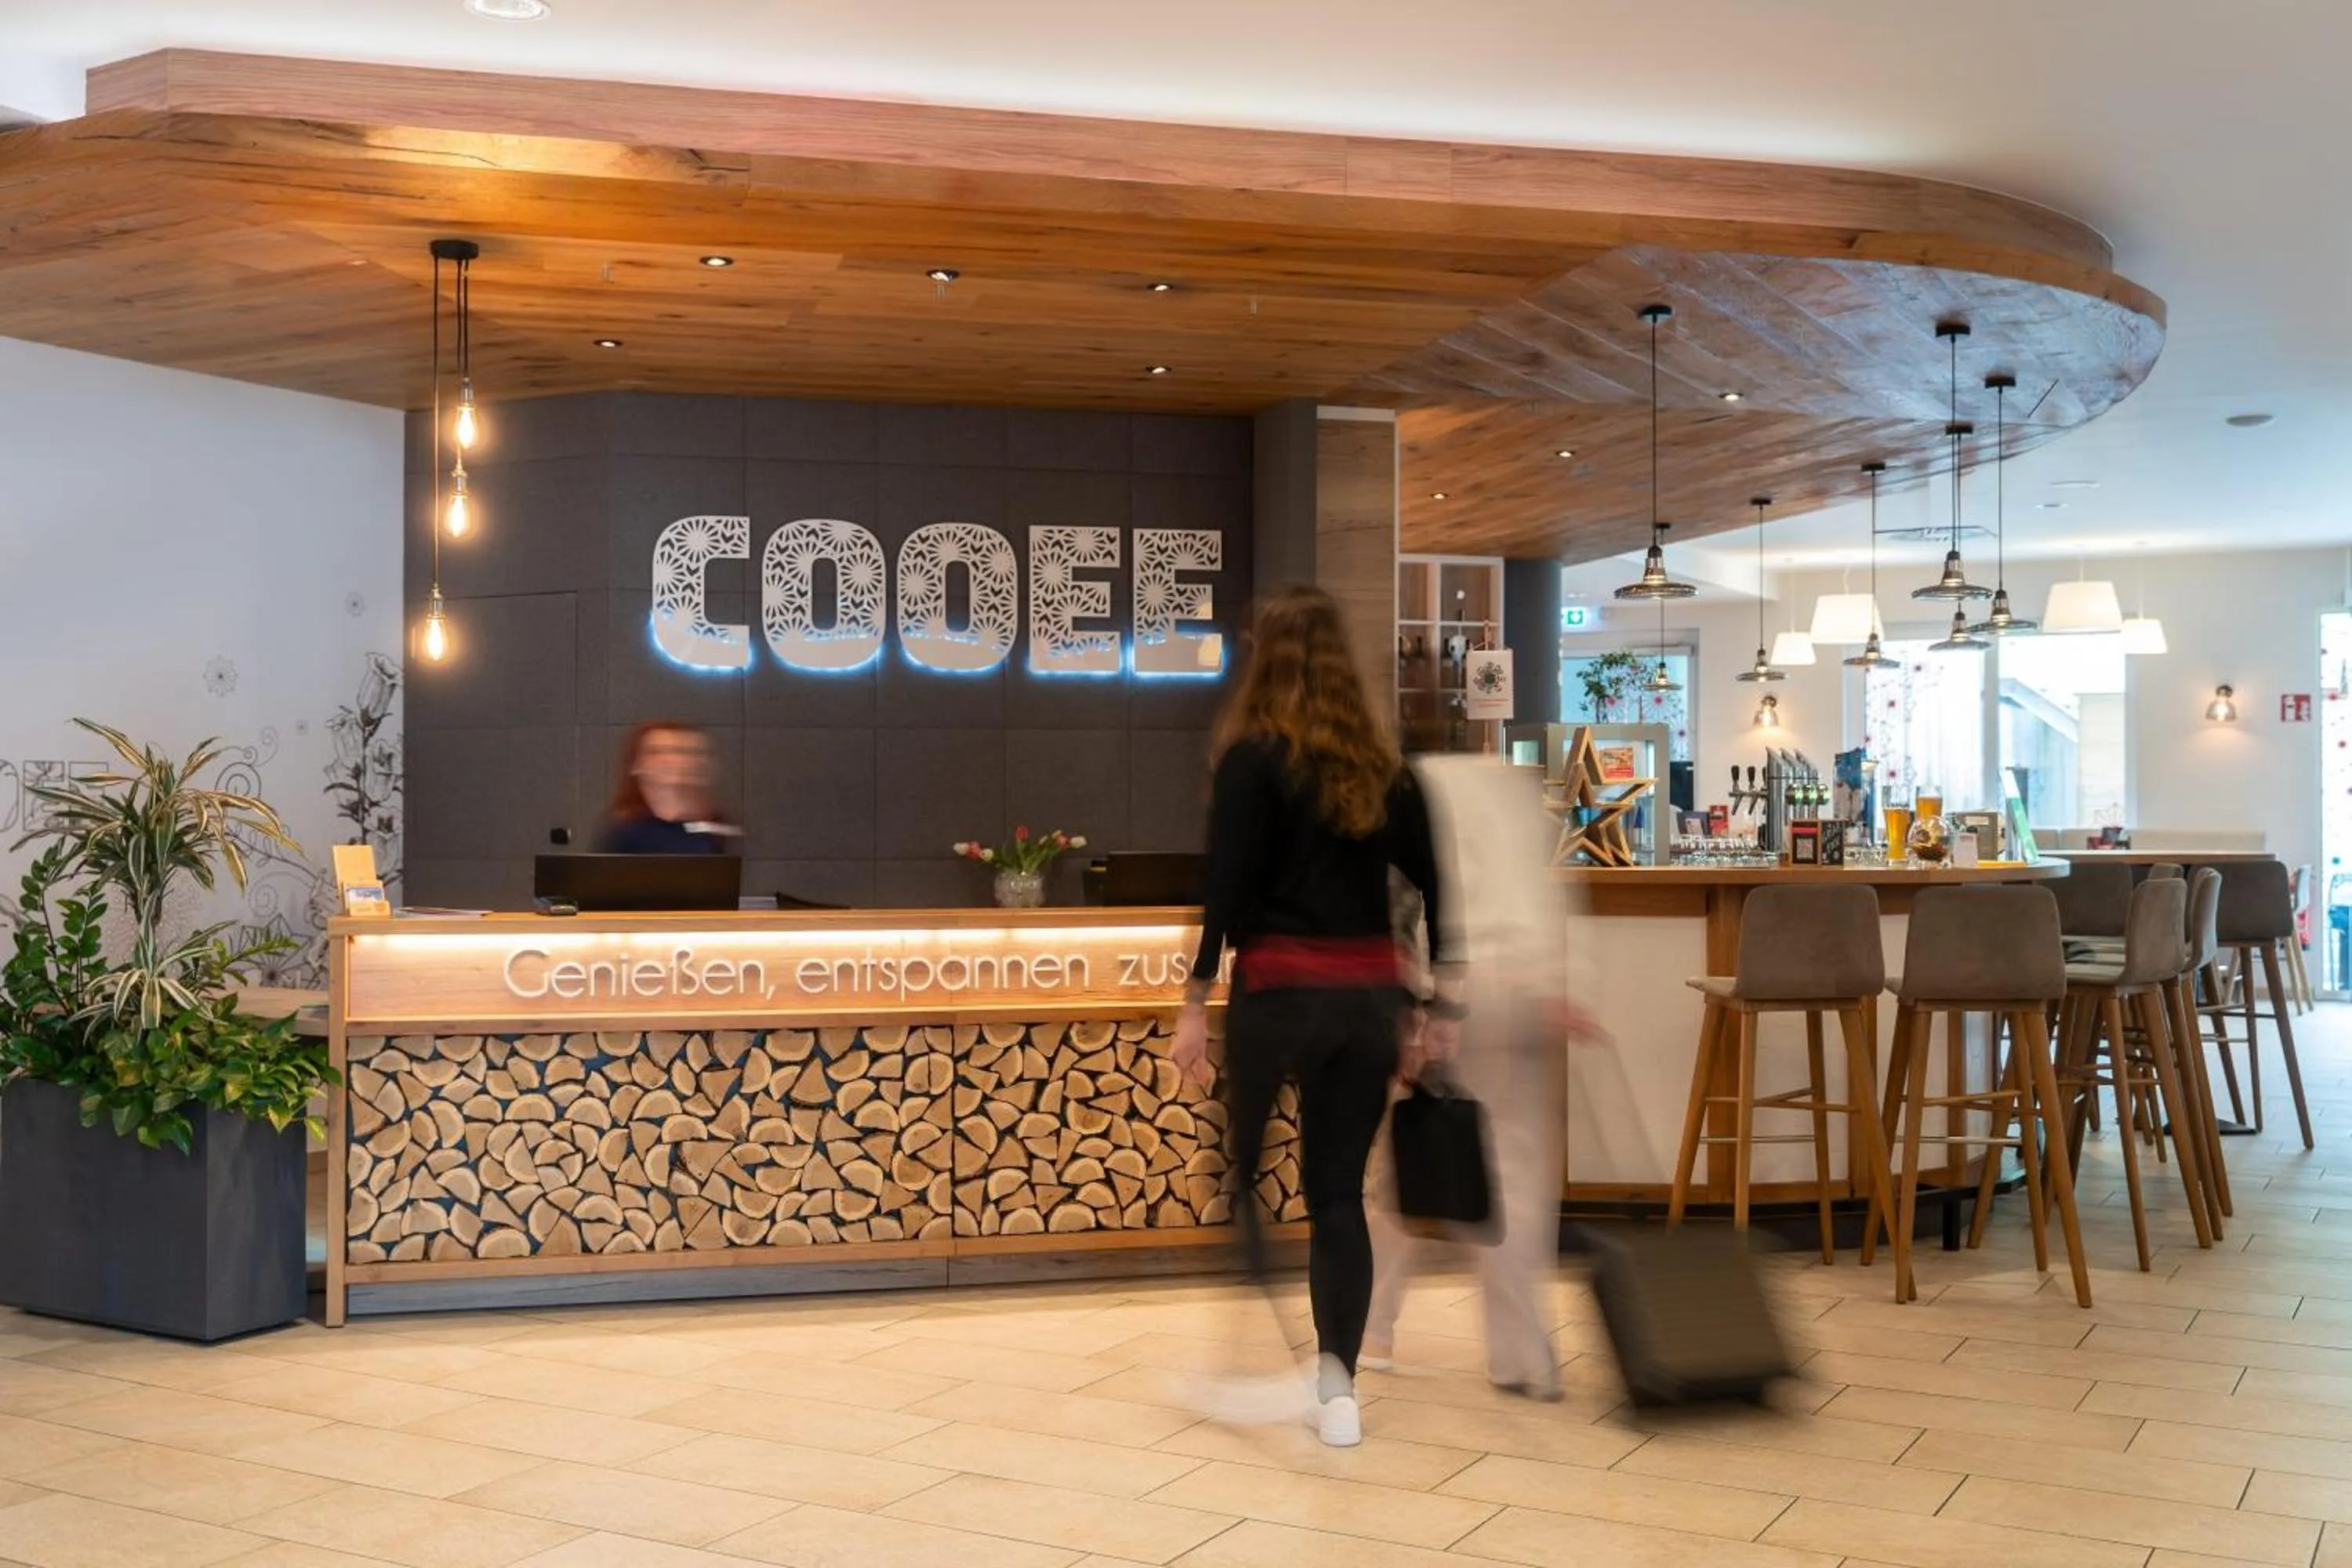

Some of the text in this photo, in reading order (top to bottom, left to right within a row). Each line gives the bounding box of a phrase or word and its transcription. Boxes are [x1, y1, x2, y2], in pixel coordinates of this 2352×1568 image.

[652, 515, 1223, 674] COOEE
[503, 949, 775, 1000] Genießen,
[795, 949, 1090, 1001] entspannen
